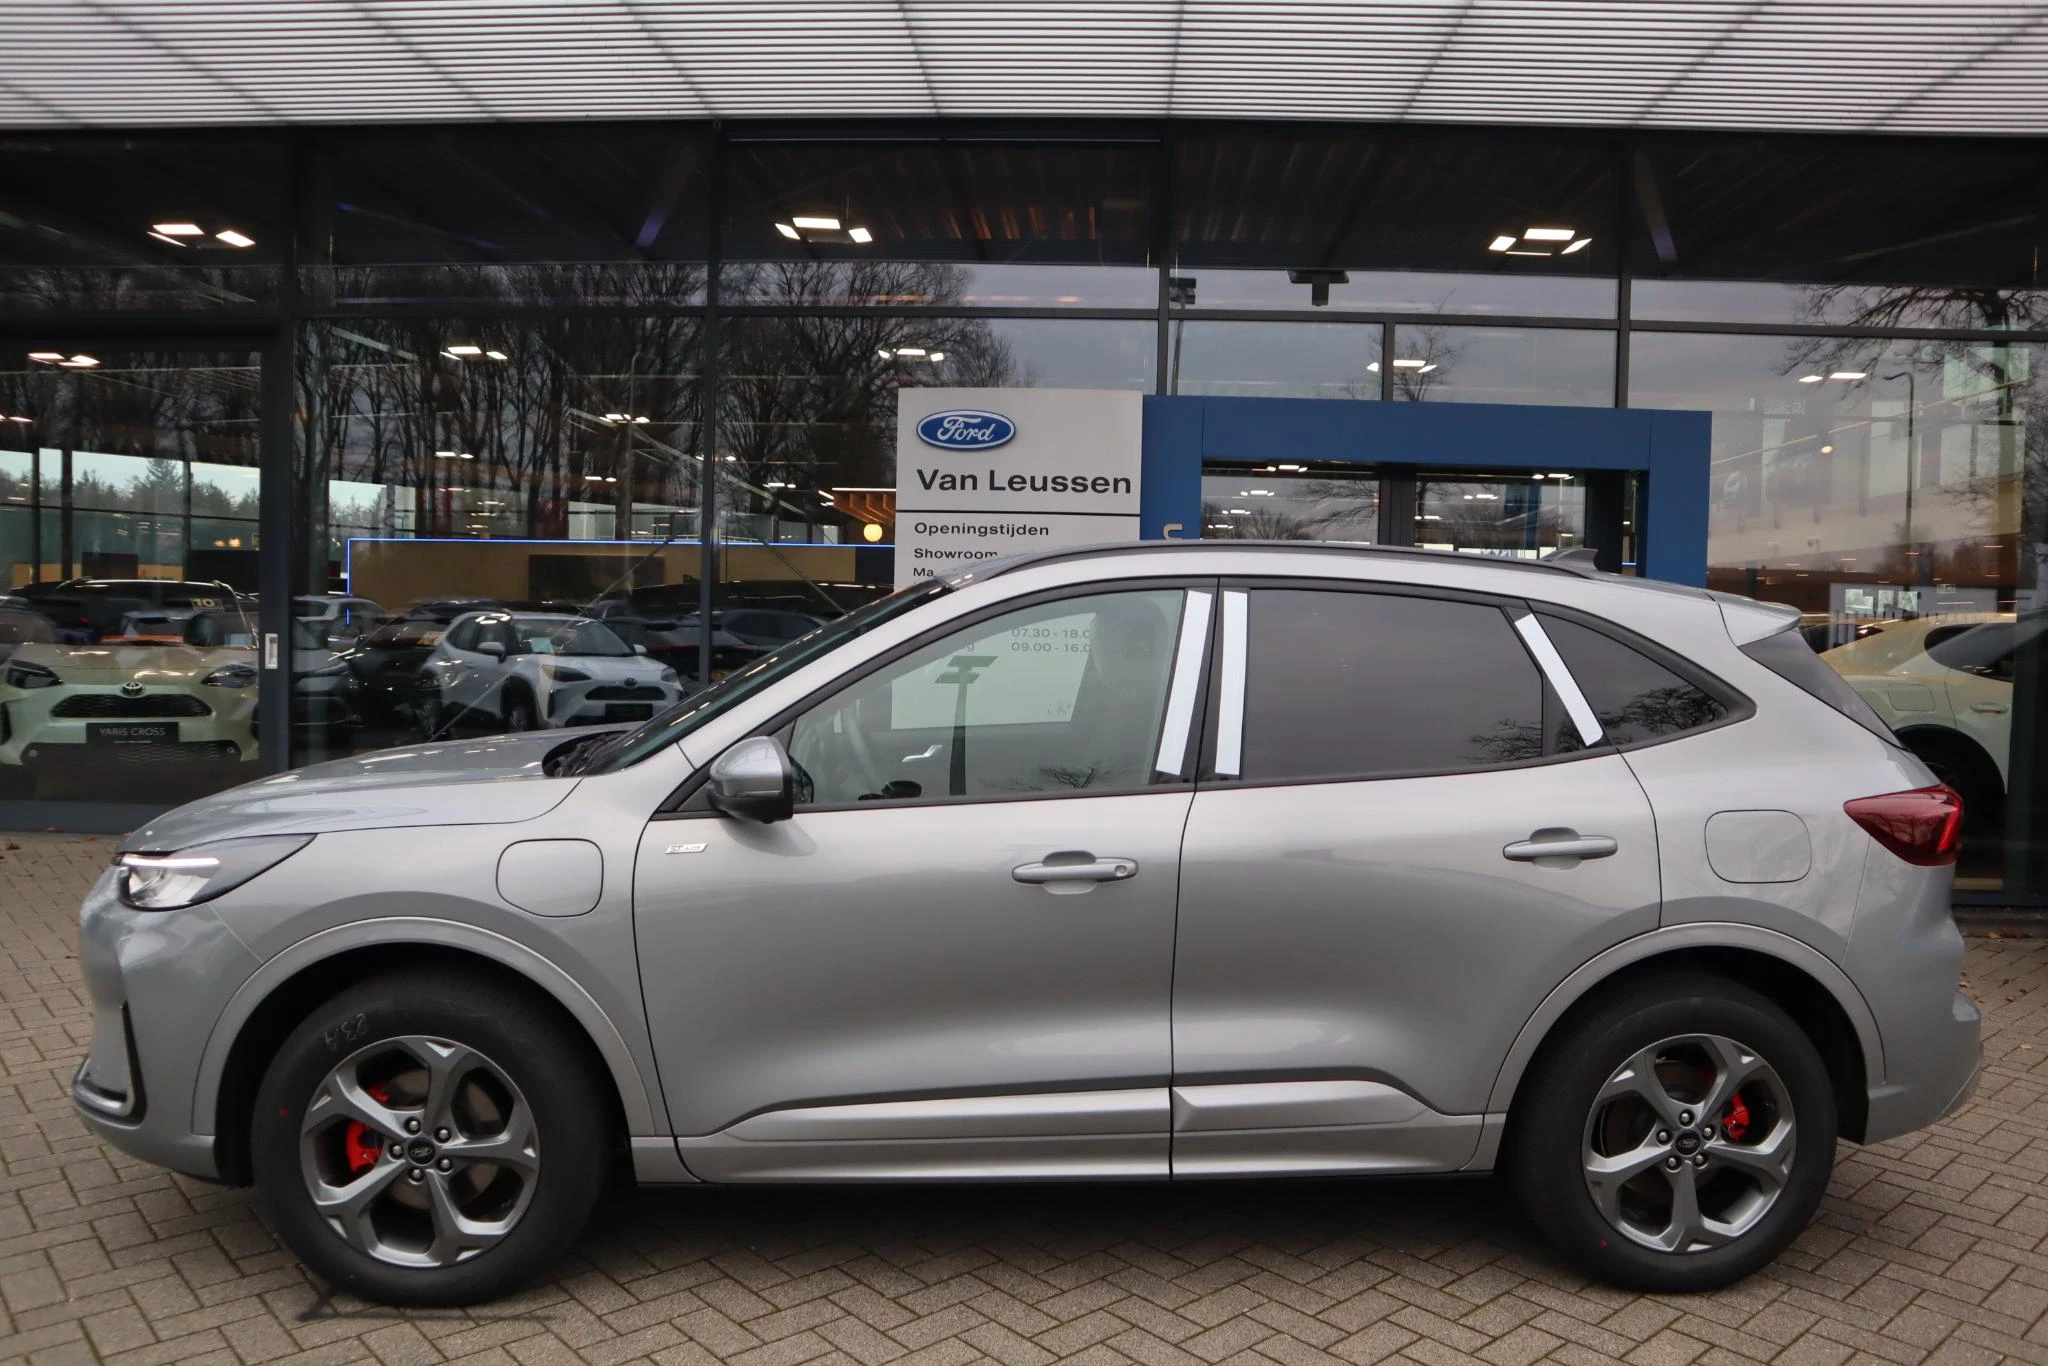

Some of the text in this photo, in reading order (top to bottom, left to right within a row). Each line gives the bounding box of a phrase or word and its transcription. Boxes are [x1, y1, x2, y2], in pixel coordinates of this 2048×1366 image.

[937, 416, 995, 441] Ford
[916, 469, 1132, 494] Van Leussen
[914, 522, 1050, 538] Openingstijden
[1011, 627, 1050, 638] 07.30
[1011, 641, 1052, 652] 09.00
[99, 727, 166, 736] YARIS CROSS
